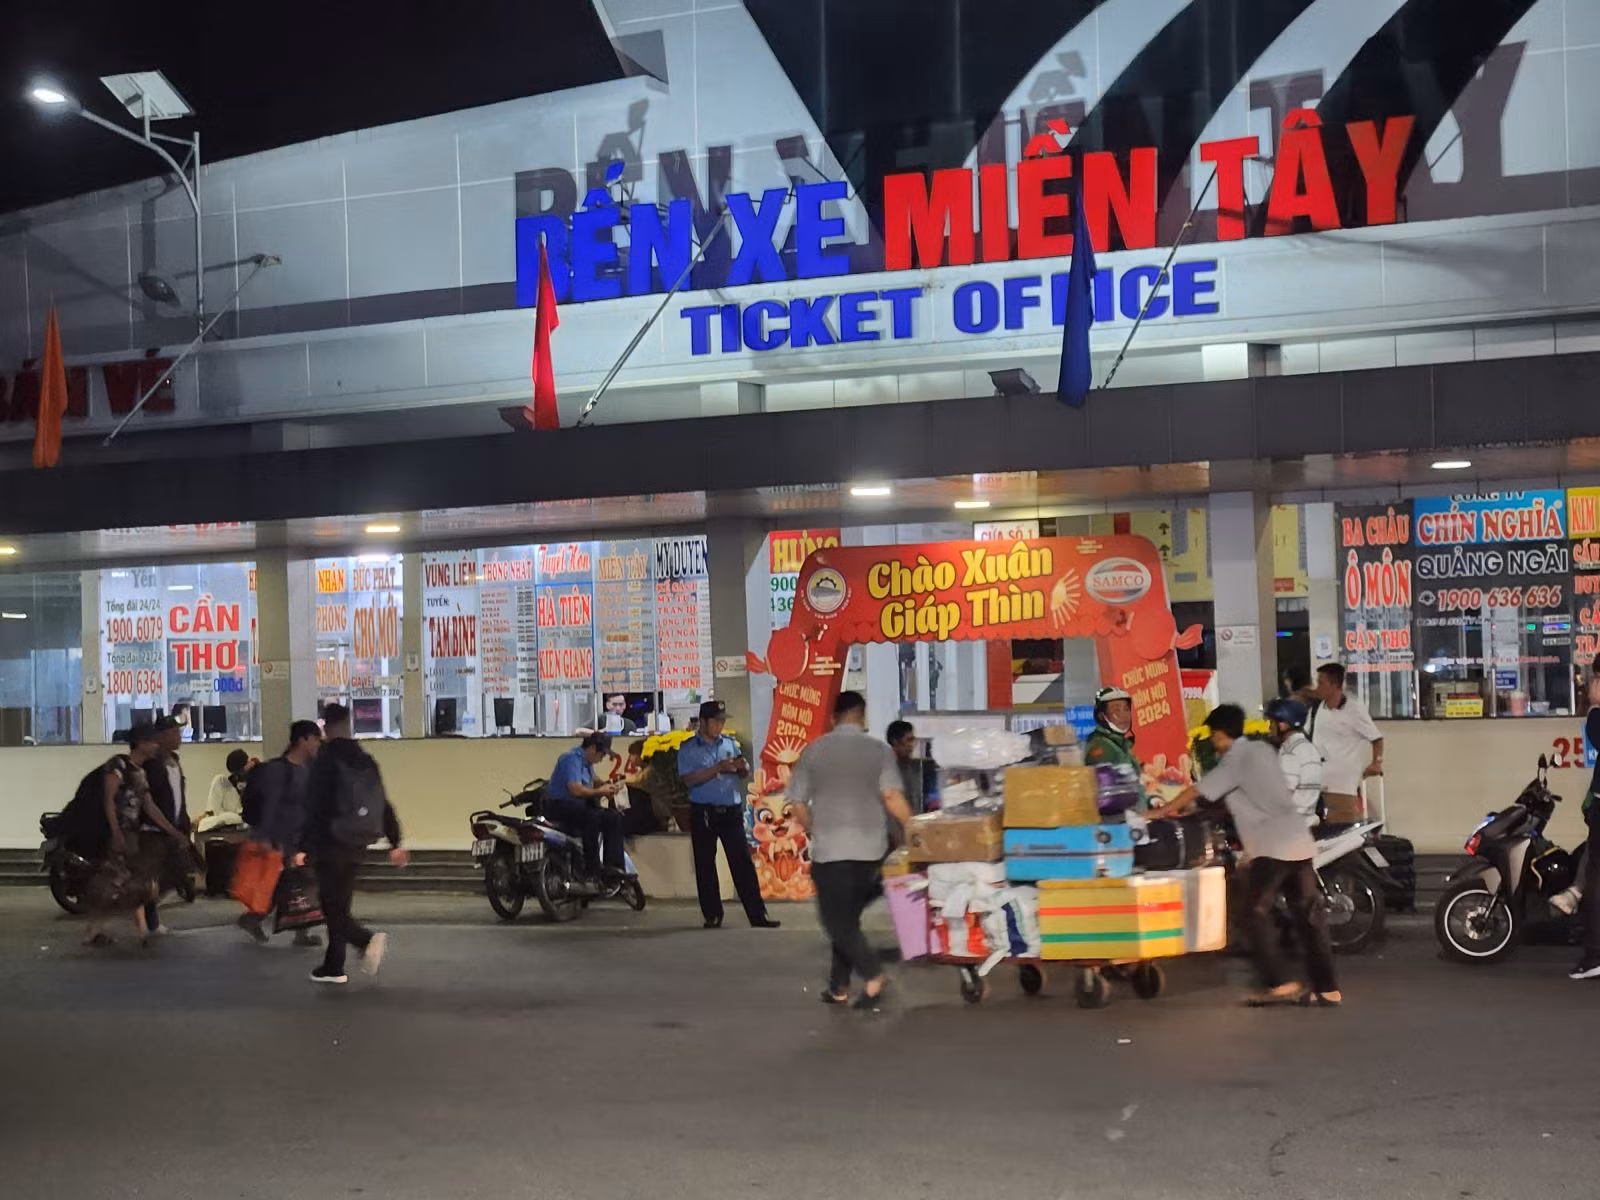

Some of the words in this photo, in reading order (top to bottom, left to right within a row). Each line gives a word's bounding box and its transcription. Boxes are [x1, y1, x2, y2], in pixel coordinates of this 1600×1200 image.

[725, 181, 850, 286] XE
[884, 118, 1157, 271] MIỀN
[1200, 108, 1416, 242] TÂY
[680, 286, 923, 356] TICKET
[1418, 502, 1477, 544] CHÍN
[1482, 498, 1564, 542] NGHĨA
[425, 556, 450, 588] VŨNG
[453, 556, 476, 586] LIÊM
[868, 554, 957, 599] Chào
[960, 541, 1054, 588] Xuân
[1345, 548, 1362, 609] Ô
[1364, 546, 1412, 609] MÔN
[1416, 546, 1503, 579] QUẢNG
[1508, 544, 1569, 575] NGÃI
[1092, 575, 1144, 588] SAMCO
[170, 594, 240, 633] CẦN
[538, 586, 554, 627] HÀ
[559, 585, 591, 626] TIÊN
[880, 594, 961, 641] Giáp
[965, 583, 1046, 627] Thìn
[1438, 588, 1483, 612] 1900
[1487, 587, 1522, 609] 636
[1525, 585, 1562, 608] 636
[172, 639, 238, 671] THƠ
[564, 648, 592, 678] GIANG
[106, 671, 133, 695] 1800
[137, 671, 163, 694] 6364
[776, 719, 808, 740] 2024
[1136, 700, 1171, 727] 2024
[609, 752, 640, 780] 24
[1551, 737, 1585, 769] 25
